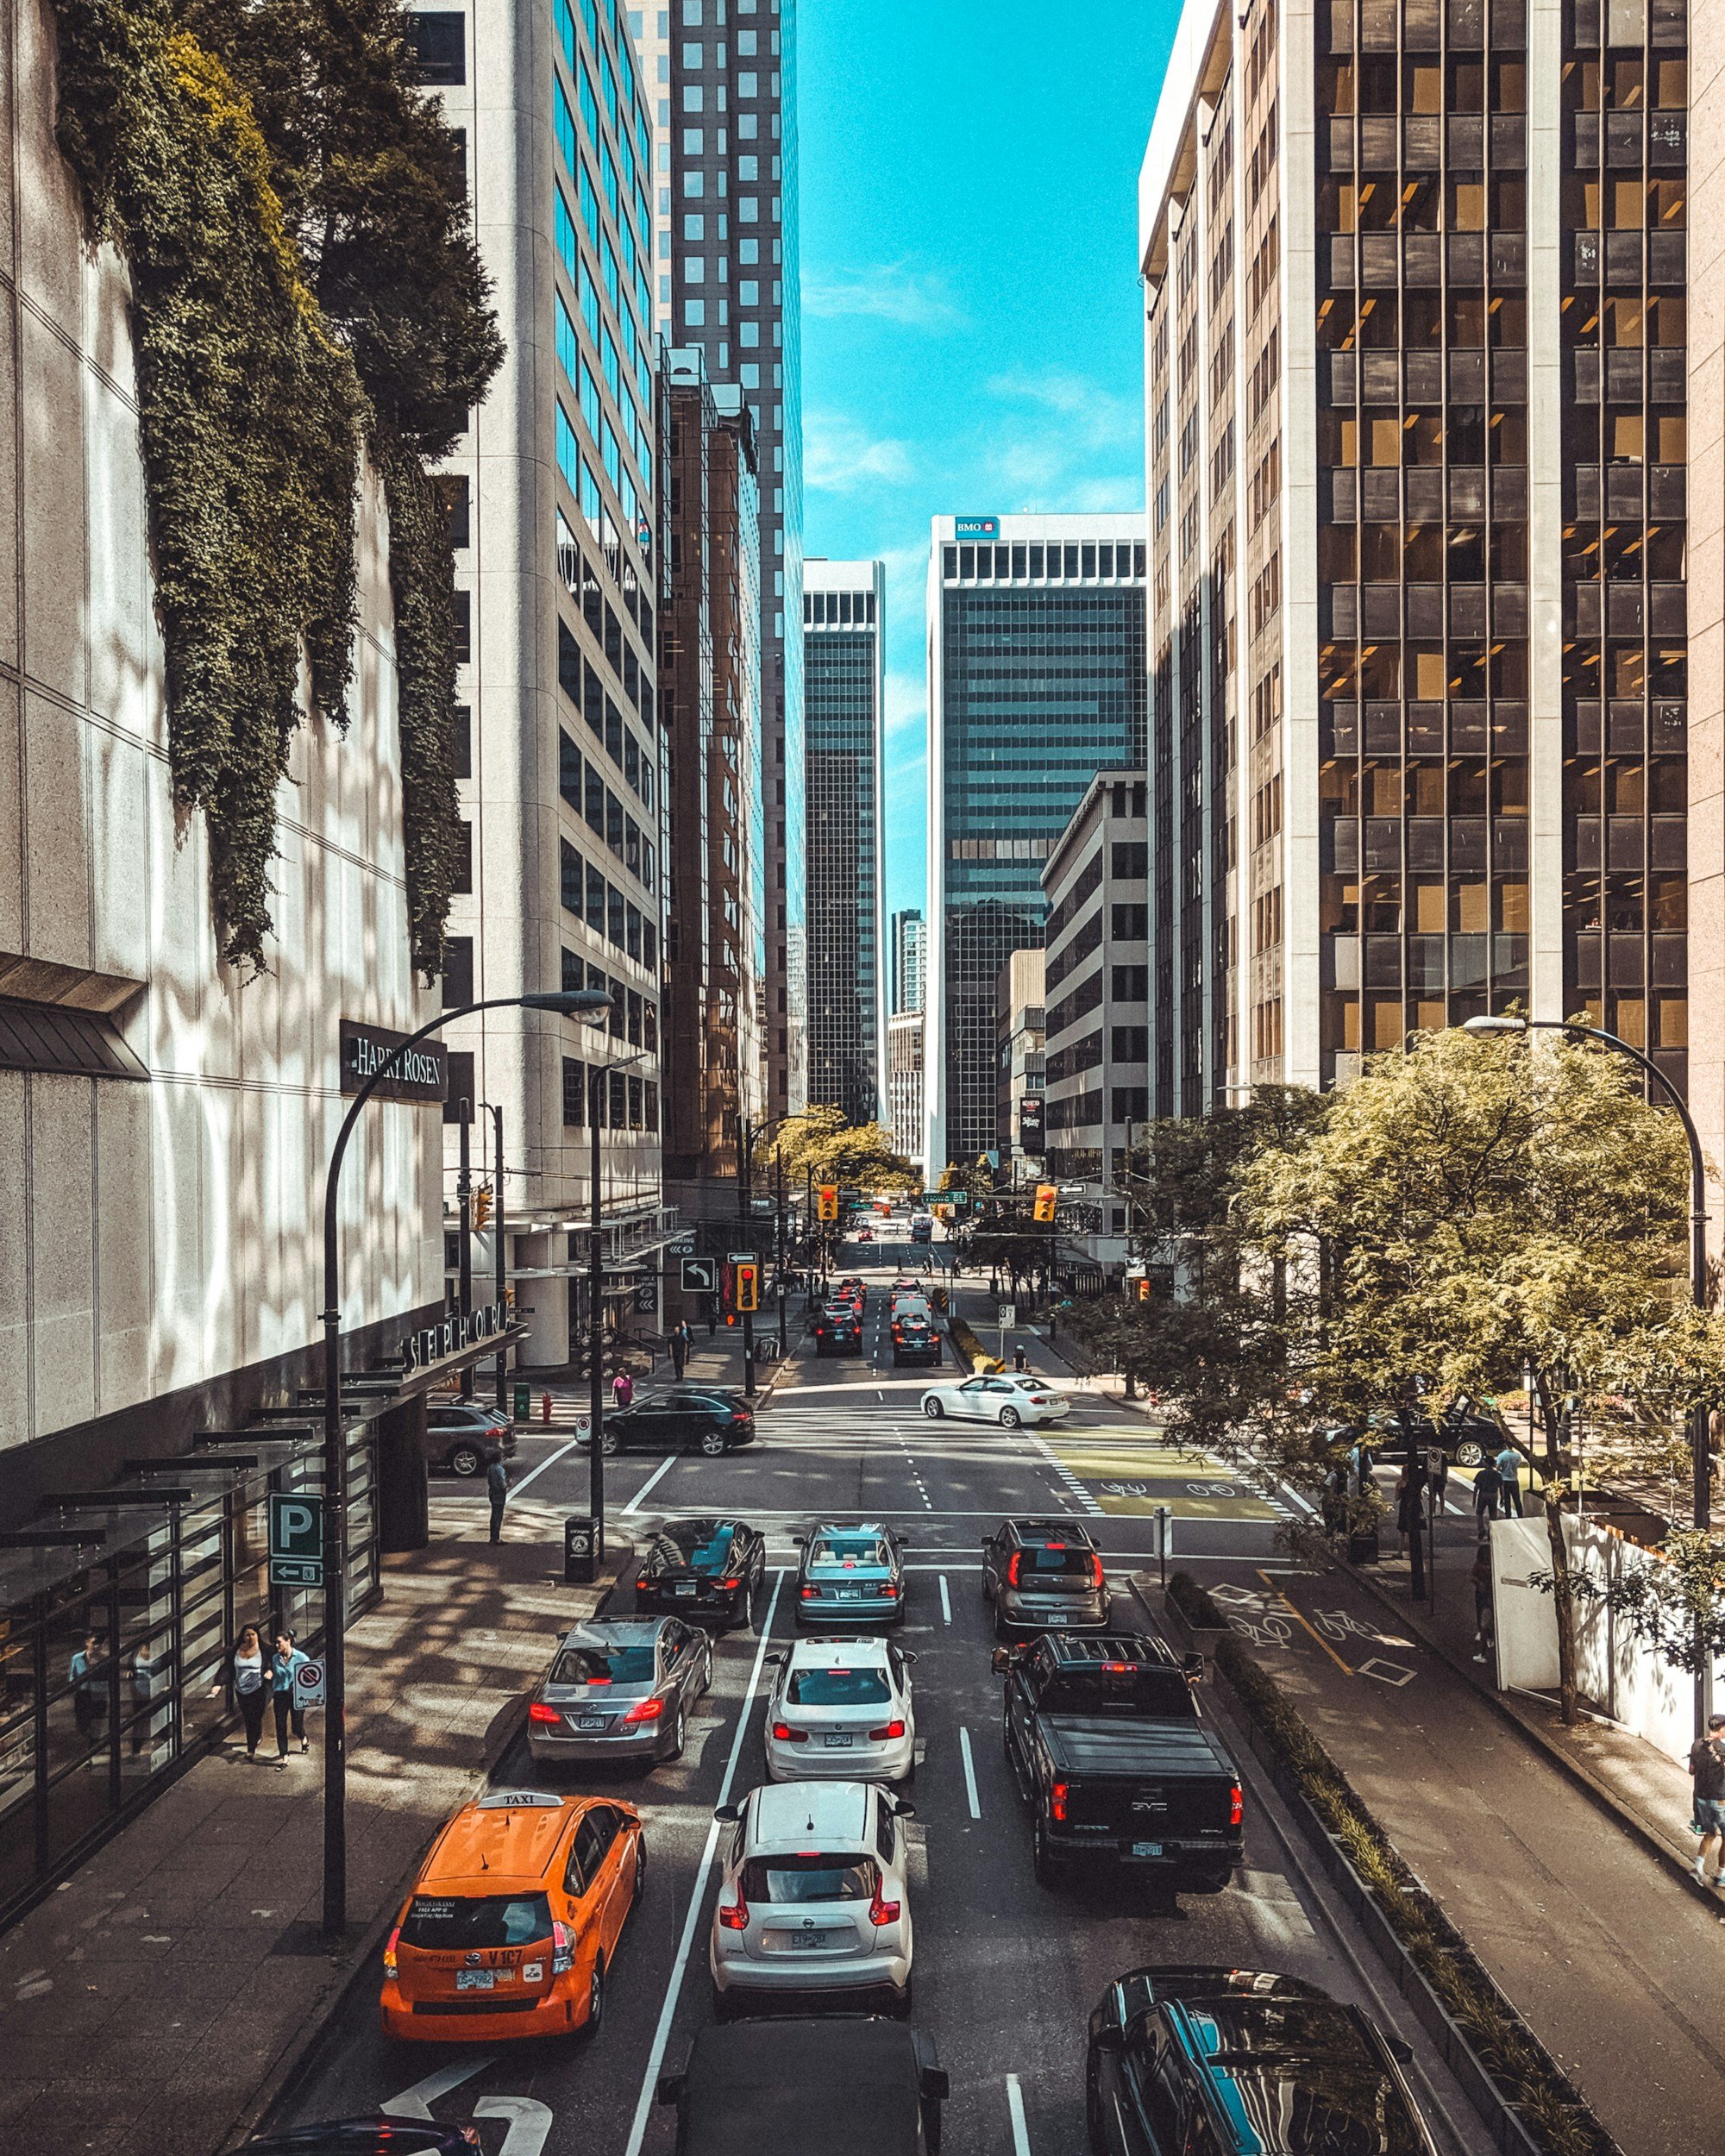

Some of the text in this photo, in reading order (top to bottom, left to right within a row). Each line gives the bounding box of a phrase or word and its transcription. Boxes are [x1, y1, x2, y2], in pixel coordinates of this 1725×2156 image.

[957, 523, 982, 532] BMO
[404, 1048, 441, 1085] ROSEN
[952, 1194, 964, 1202] St
[400, 1299, 511, 1374] SEPHORA
[280, 1504, 313, 1548] P
[504, 1795, 535, 1804] TAXI
